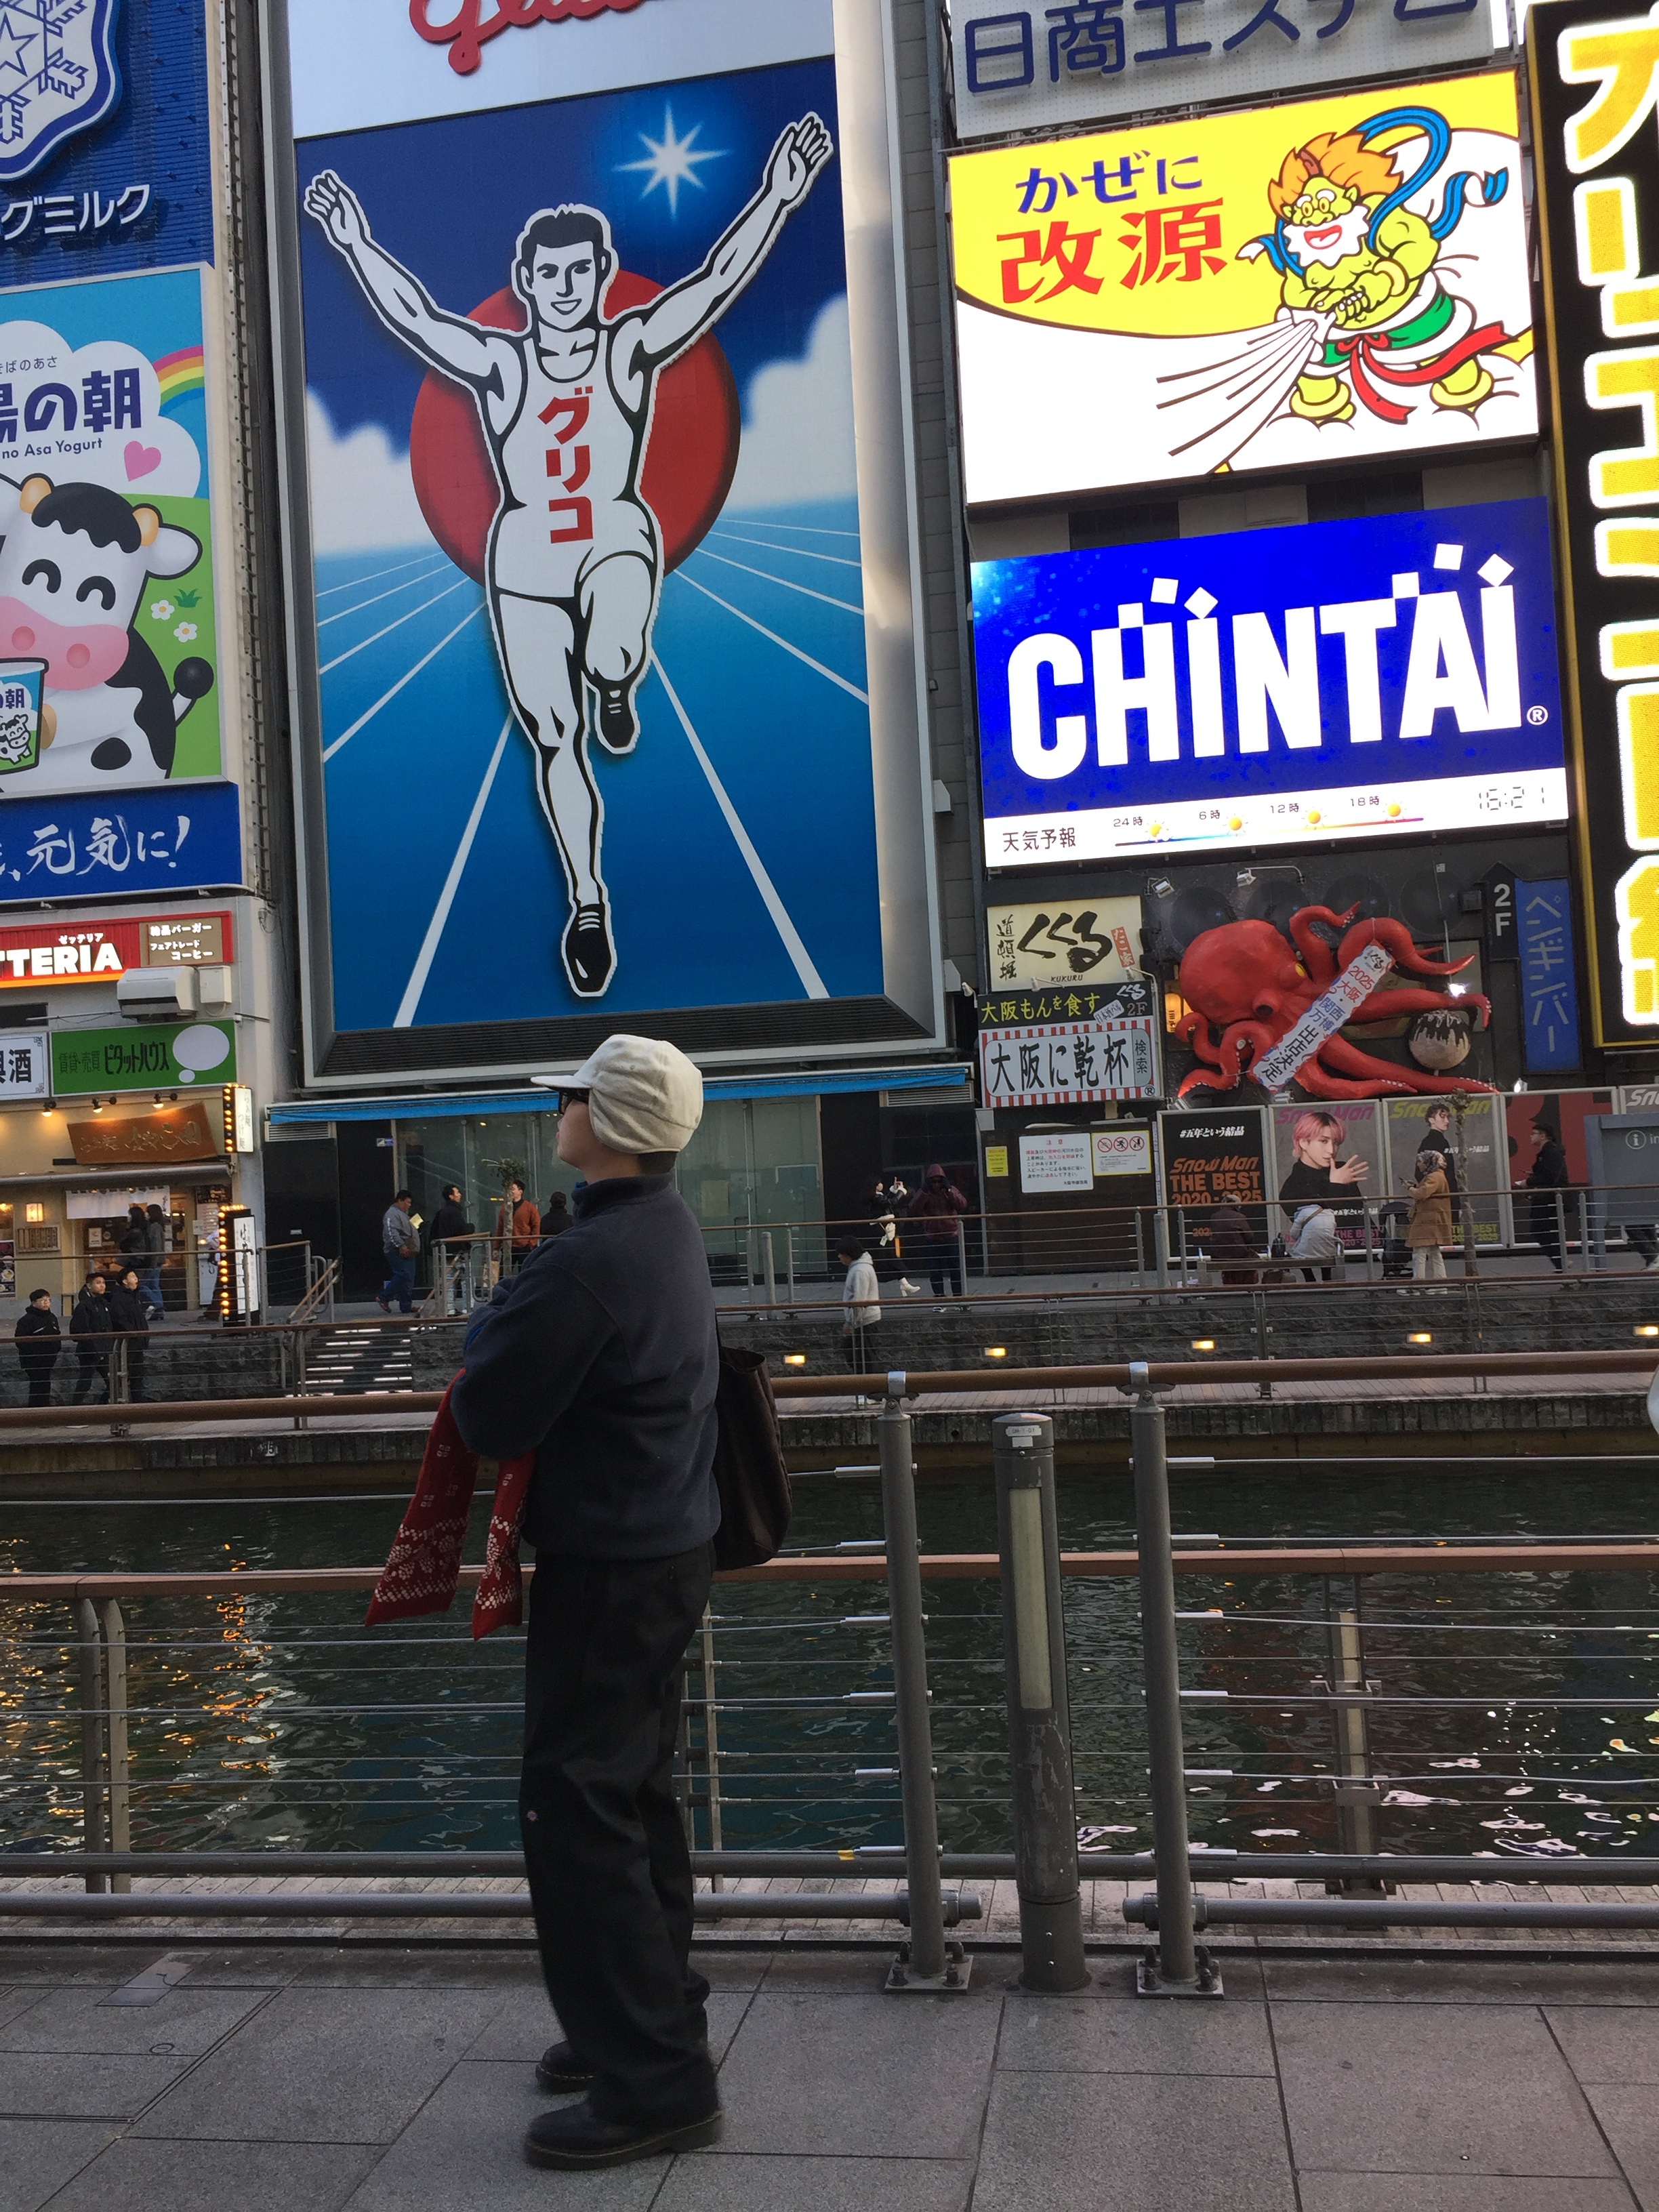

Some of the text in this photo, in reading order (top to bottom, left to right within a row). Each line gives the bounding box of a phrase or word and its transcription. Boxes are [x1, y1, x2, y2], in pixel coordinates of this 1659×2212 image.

[1015, 150, 1203, 214] かぜに
[996, 197, 1228, 304] 改源
[0, 356, 58, 374] ばのあさ
[2, 438, 102, 459] no Asa Yogurt
[537, 386, 594, 544] グリコ
[1008, 544, 1522, 780] CHINTAI
[0, 688, 25, 710] 朝
[0, 815, 191, 882] 、元気に!
[1003, 827, 1076, 853] 天気予報
[58, 933, 104, 945] ゼッテリア
[150, 939, 200, 951] フェアトレード
[996, 914, 1017, 981] 道頓堀
[1017, 911, 1113, 973] くくる
[0, 943, 123, 977] TERIA
[171, 949, 213, 960] コーヒー
[1050, 975, 1084, 983] KUKURU
[1348, 965, 1375, 990] 2025
[1525, 895, 1570, 1052] ペンギンバー
[1116, 983, 1146, 1000] くくる
[1336, 980, 1363, 1003] 大阪
[981, 993, 1101, 1023] 大阪もんを食す
[1126, 1002, 1148, 1017] 2F
[1309, 1008, 1335, 1031] 万博
[1319, 996, 1346, 1021] 関西
[104, 1041, 169, 1075] ピタットハウス
[990, 1034, 1130, 1094] 大阪に乾杯
[1134, 1040, 1148, 1074] 検索
[1261, 1024, 1319, 1083] 出店決定
[1626, 1088, 1659, 1106] Sn
[1170, 1155, 1258, 1174] Snow Man
[1170, 1171, 1261, 1192] THE BEST
